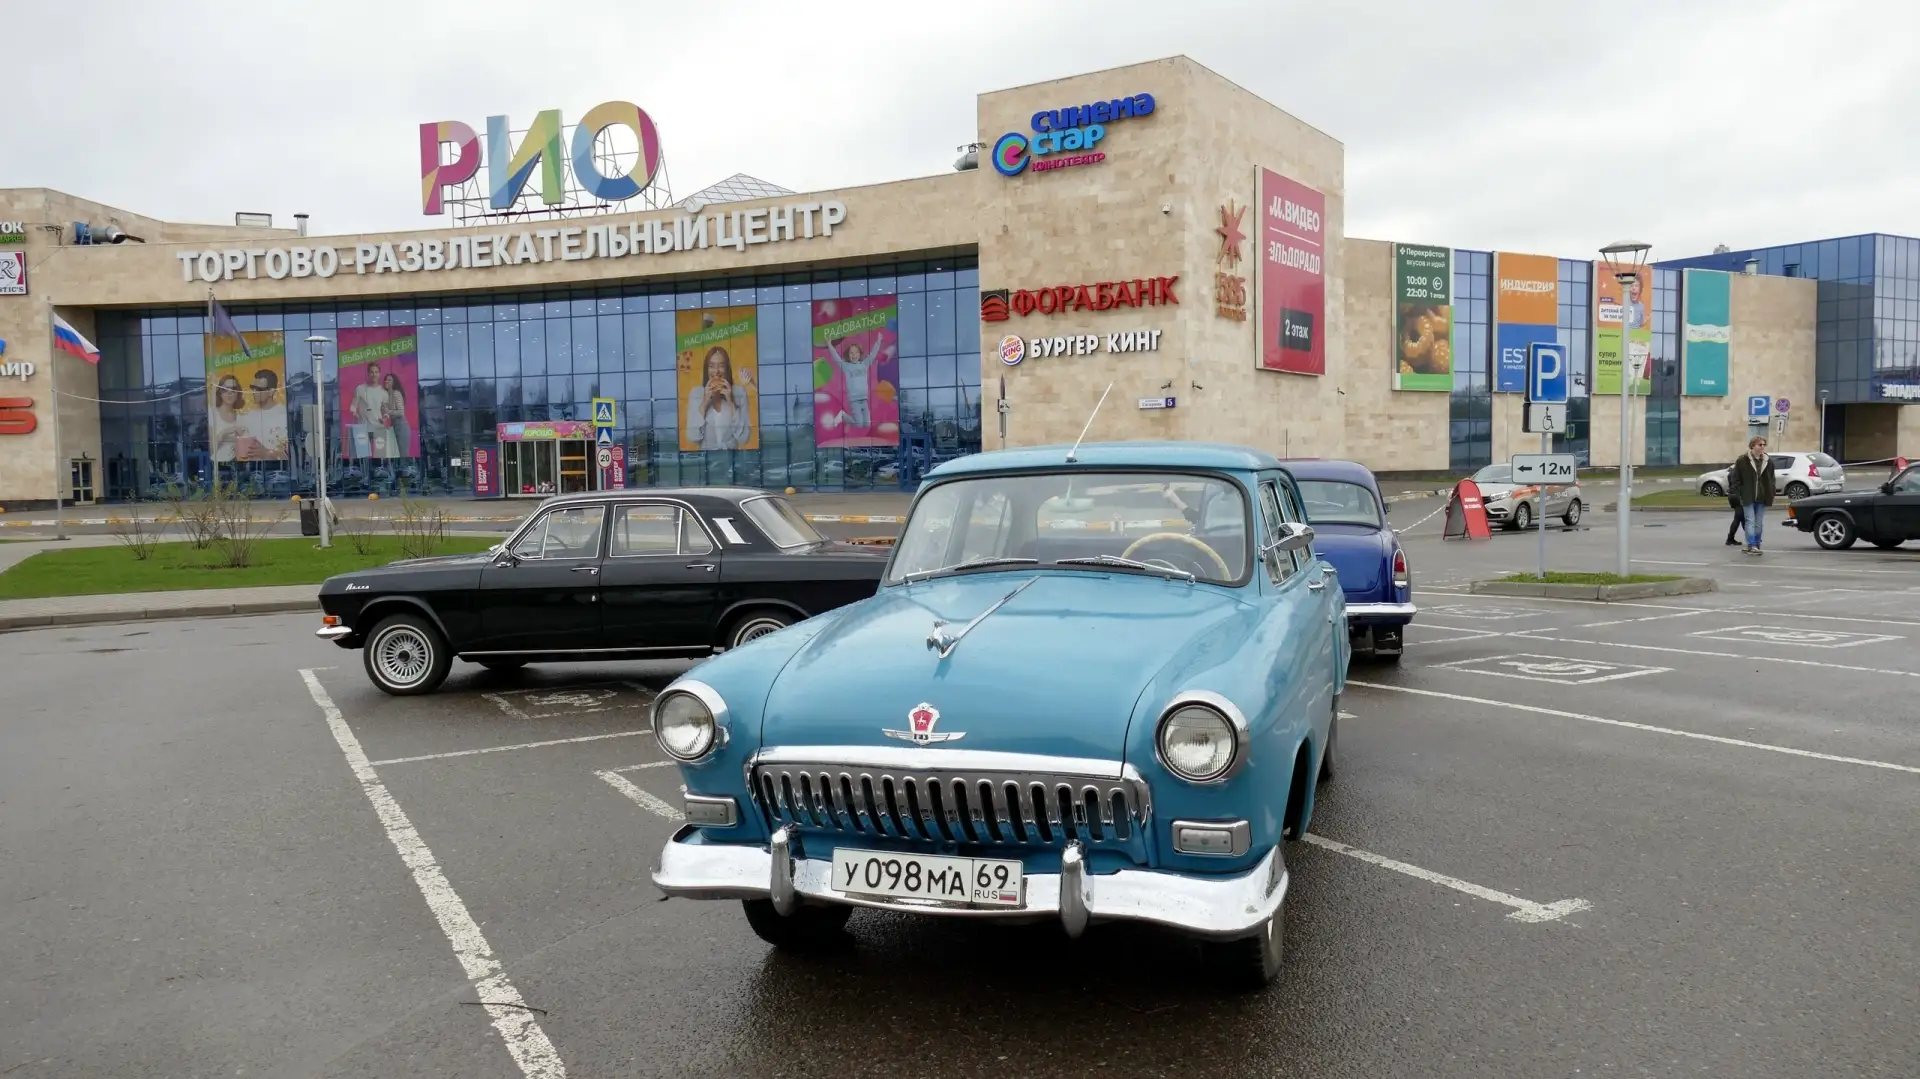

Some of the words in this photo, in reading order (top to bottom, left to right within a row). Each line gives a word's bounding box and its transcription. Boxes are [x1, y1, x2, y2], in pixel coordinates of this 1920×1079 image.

[420, 100, 661, 215] РИО
[1269, 196, 1320, 233] М.ВИДЕО
[176, 195, 708, 283] ТОРГОВО-РАЗВЛЕКАТЕЛЬНЫЙ
[716, 201, 847, 251] ЦЕНТР
[1269, 241, 1320, 275] ЭЛЬДОРАДО
[1406, 248, 1445, 259] Перекрёсток
[1406, 276, 1427, 285] 10:00
[1406, 288, 1427, 298] 22:00
[1012, 276, 1180, 317] ФОРАБАНК
[684, 321, 748, 347] НАСЛАЖДАТЬСЯ
[823, 312, 886, 338] РАДОВАТЬСЯ
[1285, 319, 1291, 335] 2
[1291, 324, 1309, 339] этаж
[341, 347, 388, 364] ВЫБИРАТЬ
[390, 339, 413, 351] СЕБЯ
[1003, 345, 1021, 358] KING
[1030, 335, 1099, 358] БУРГЕР
[1107, 330, 1161, 353] КИНГ
[1537, 348, 1561, 397] P
[1167, 398, 1173, 406] 5
[1752, 398, 1766, 415] P
[600, 454, 610, 463] 20
[976, 864, 1009, 889] 69
[974, 889, 998, 900] RUS
